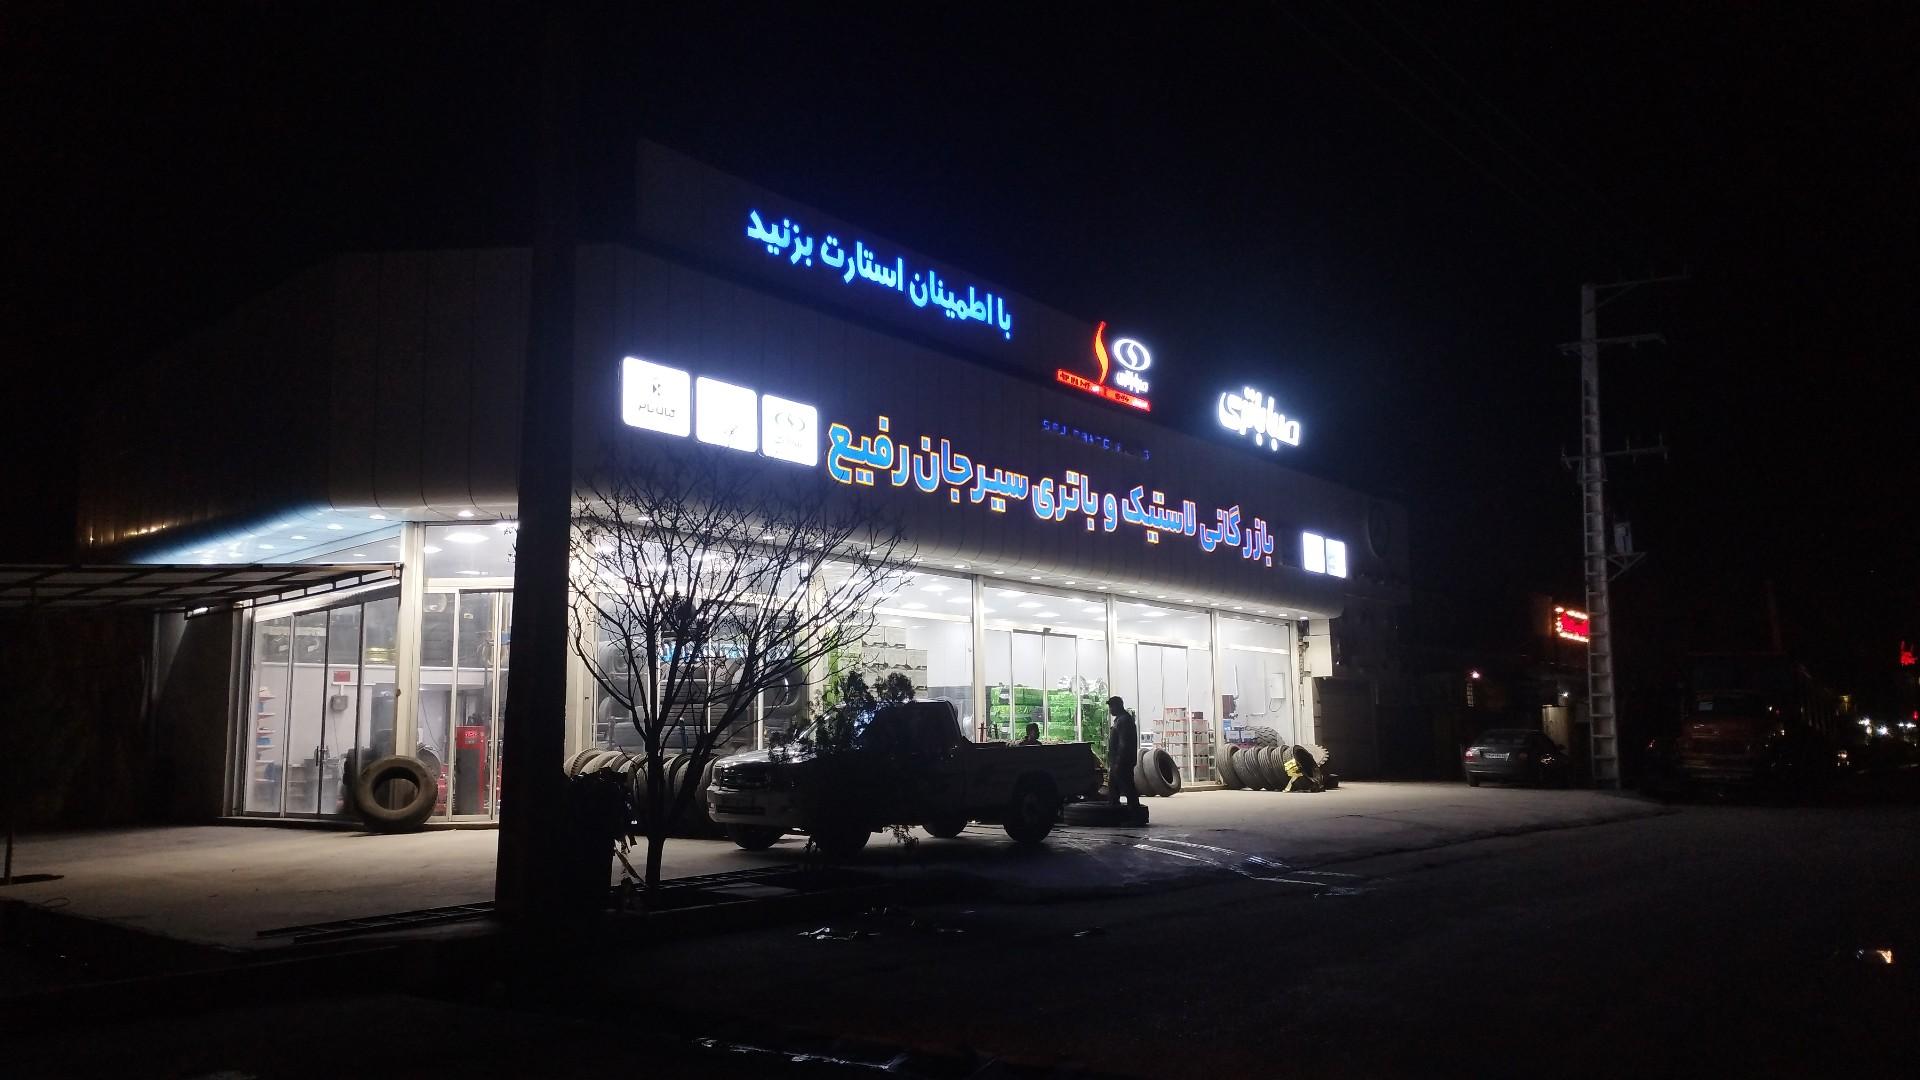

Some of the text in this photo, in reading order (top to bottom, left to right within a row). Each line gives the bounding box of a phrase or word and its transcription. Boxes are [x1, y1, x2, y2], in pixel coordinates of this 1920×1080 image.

[747, 209, 1011, 340] با اطمینان استارت بزنید
[828, 415, 910, 487] رفیع
[913, 435, 1029, 513] سیرجان
[1032, 470, 1099, 530] باتری
[1103, 493, 1118, 532] و
[1122, 485, 1197, 543] لاستیک
[1199, 505, 1275, 567] بازرگانی
